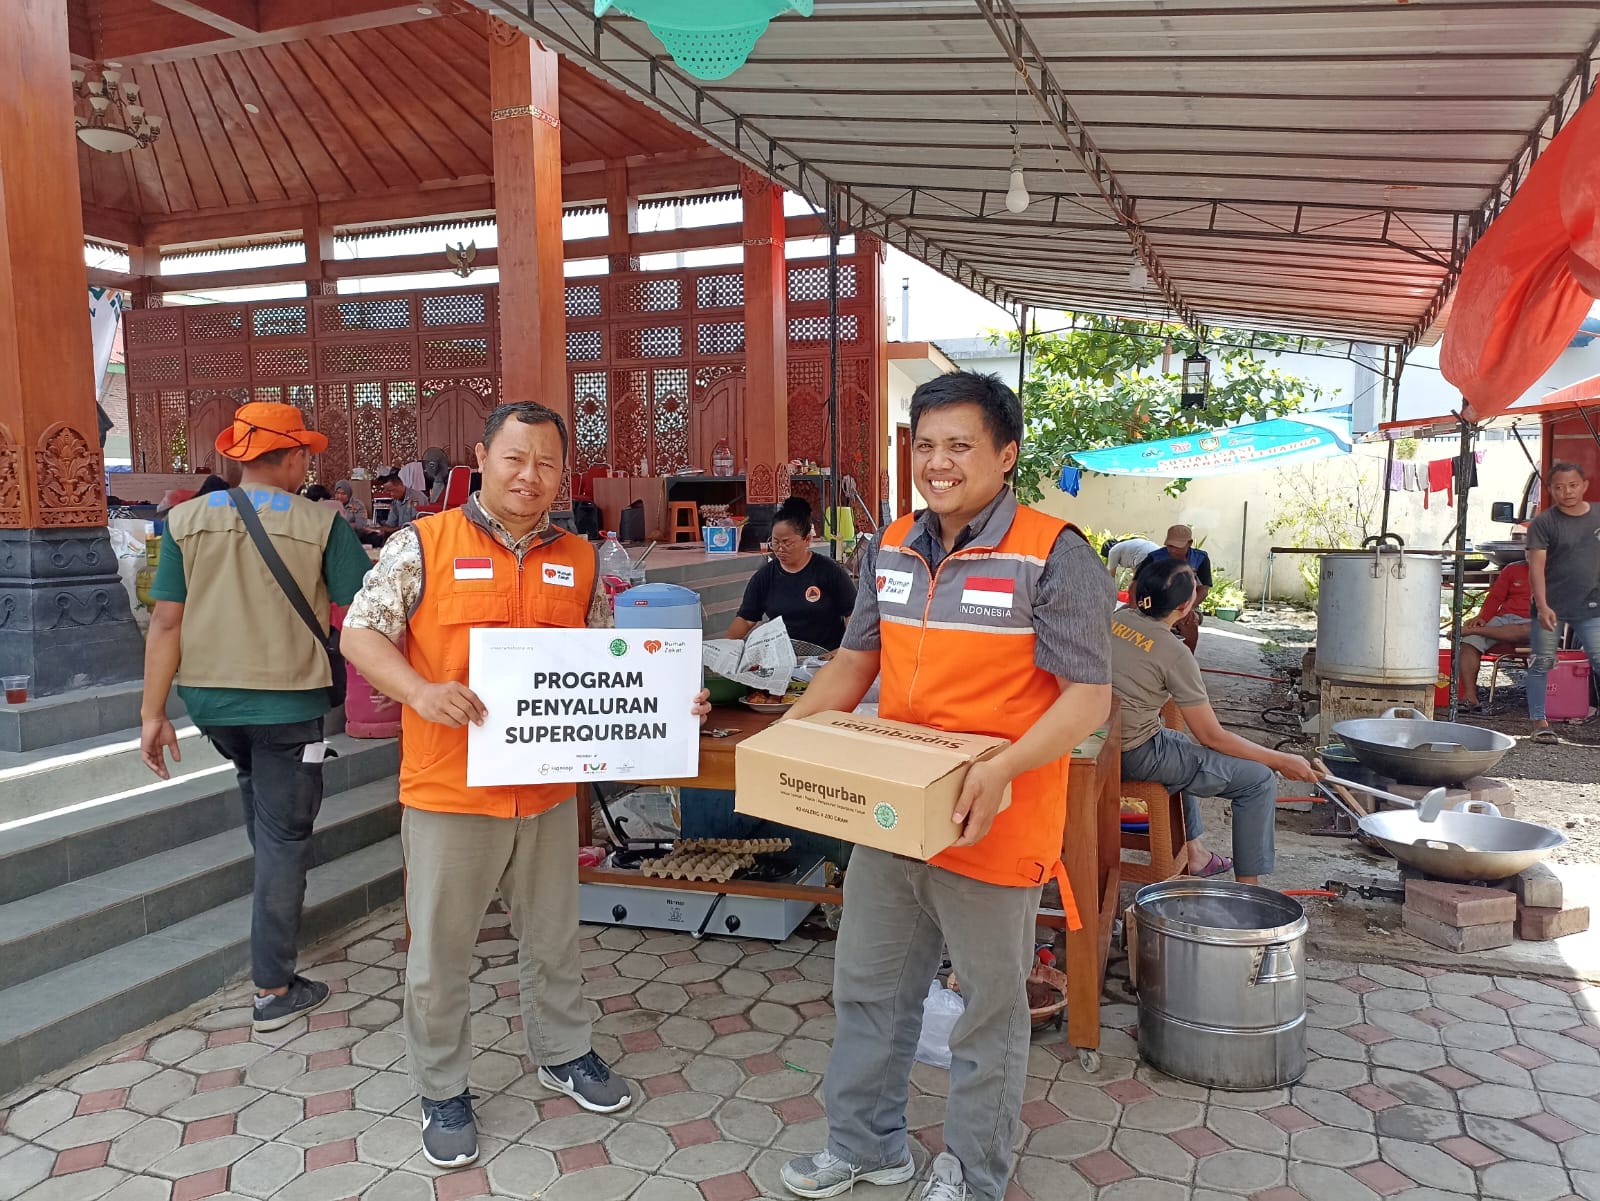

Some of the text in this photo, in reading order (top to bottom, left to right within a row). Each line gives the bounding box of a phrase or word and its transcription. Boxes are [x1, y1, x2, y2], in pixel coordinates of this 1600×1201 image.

[207, 489, 291, 512] BPB
[959, 605, 1012, 618] INDONESIA
[533, 671, 643, 689] PROGRAM
[516, 697, 658, 716] PENYALURAN
[505, 722, 667, 744] SUPERQURBAN
[831, 721, 964, 749] Superqurban
[779, 772, 866, 805] Superqurban
